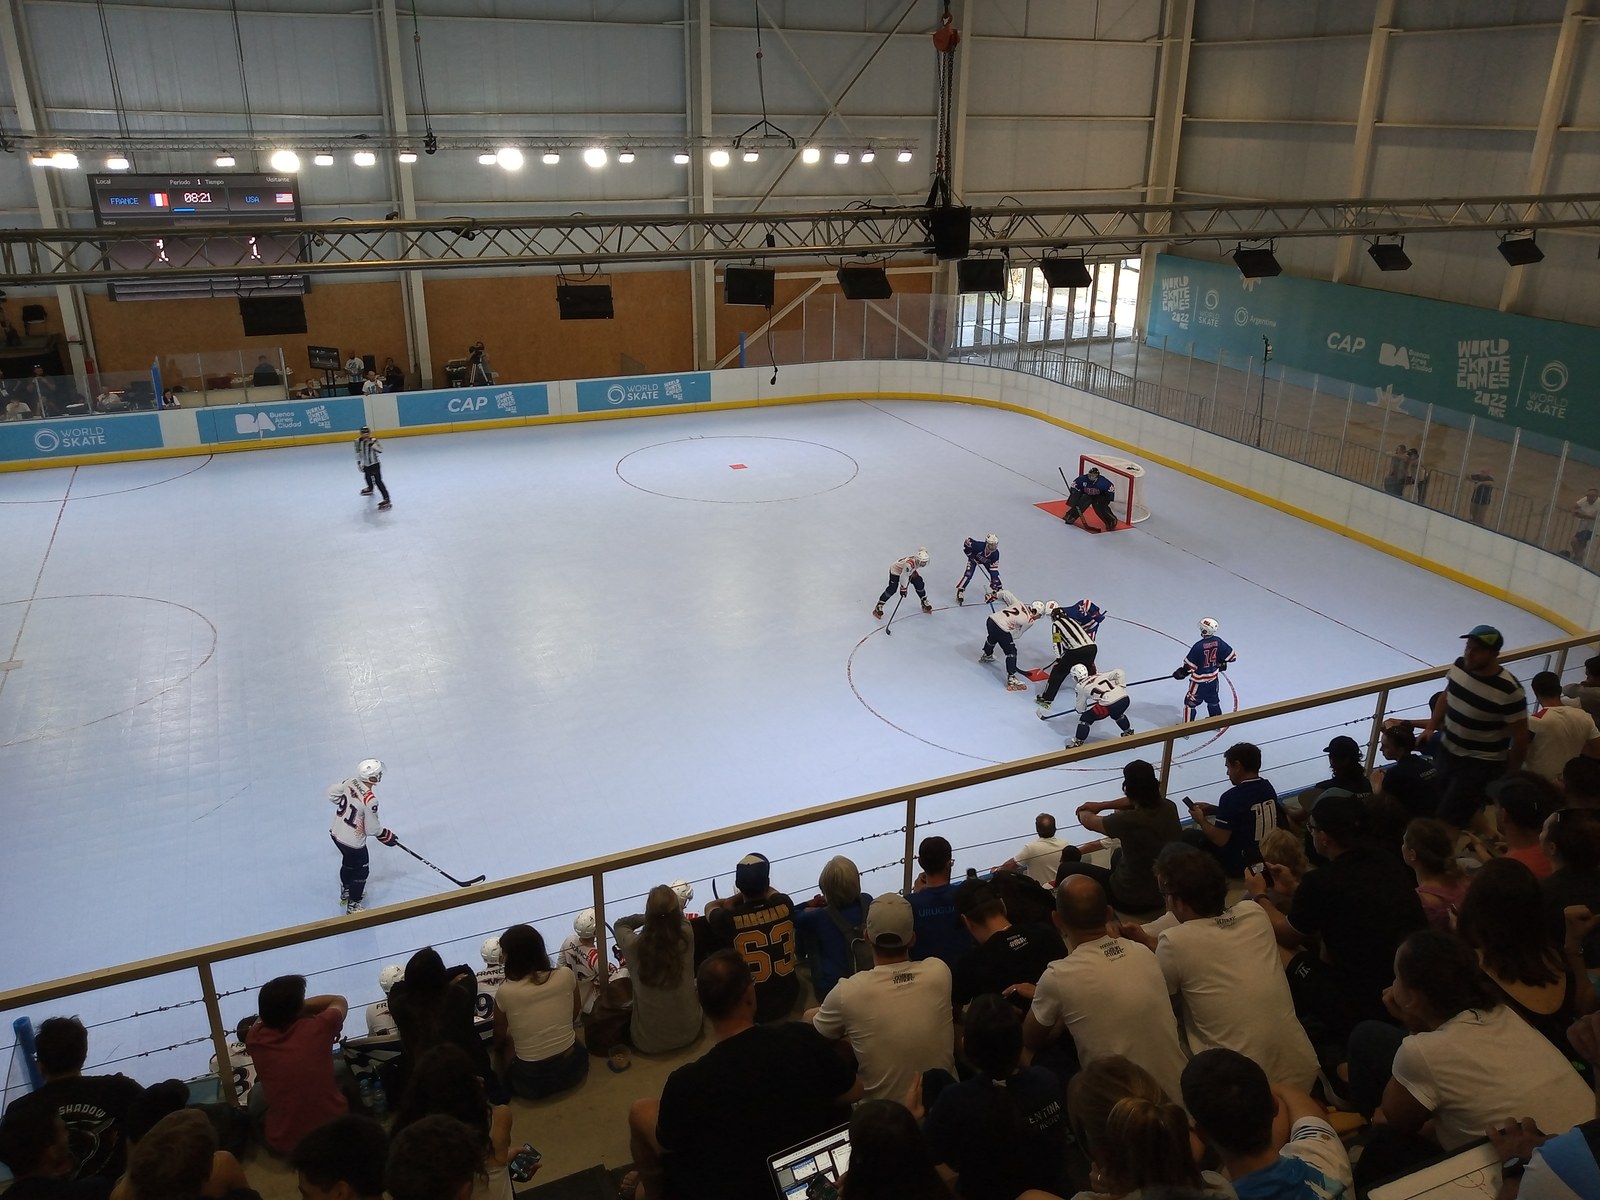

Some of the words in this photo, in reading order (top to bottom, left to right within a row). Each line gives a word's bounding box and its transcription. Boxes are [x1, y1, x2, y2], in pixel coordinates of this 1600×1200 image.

[197, 178, 202, 186] 1
[110, 197, 140, 205] FRANCE
[184, 192, 212, 203] 08:21
[245, 196, 260, 204] USA
[1162, 276, 1189, 290] WORLD
[1162, 286, 1190, 301] SKATE
[1198, 316, 1219, 328] SKATE
[1327, 332, 1366, 353] CAP
[1458, 338, 1509, 358] WORLD
[1458, 355, 1510, 373] SKATE
[626, 383, 659, 392] WORLD
[1457, 371, 1509, 390] GAMES
[627, 390, 659, 400] SKATE
[1529, 391, 1568, 407] WORLD
[447, 396, 488, 412] CAP
[1525, 400, 1567, 419] SKATE
[60, 426, 104, 438] WORLD
[277, 421, 302, 429] Ciudad
[62, 434, 106, 447] SKATE
[1002, 607, 1020, 618] 2
[1203, 648, 1218, 668] 14
[336, 793, 358, 829] 91
[918, 905, 955, 918] URUGU
[733, 919, 796, 983] 63
[475, 968, 505, 978] FRANC
[58, 1103, 106, 1119] SHADOW
[1028, 1101, 1061, 1124] ENTINA
